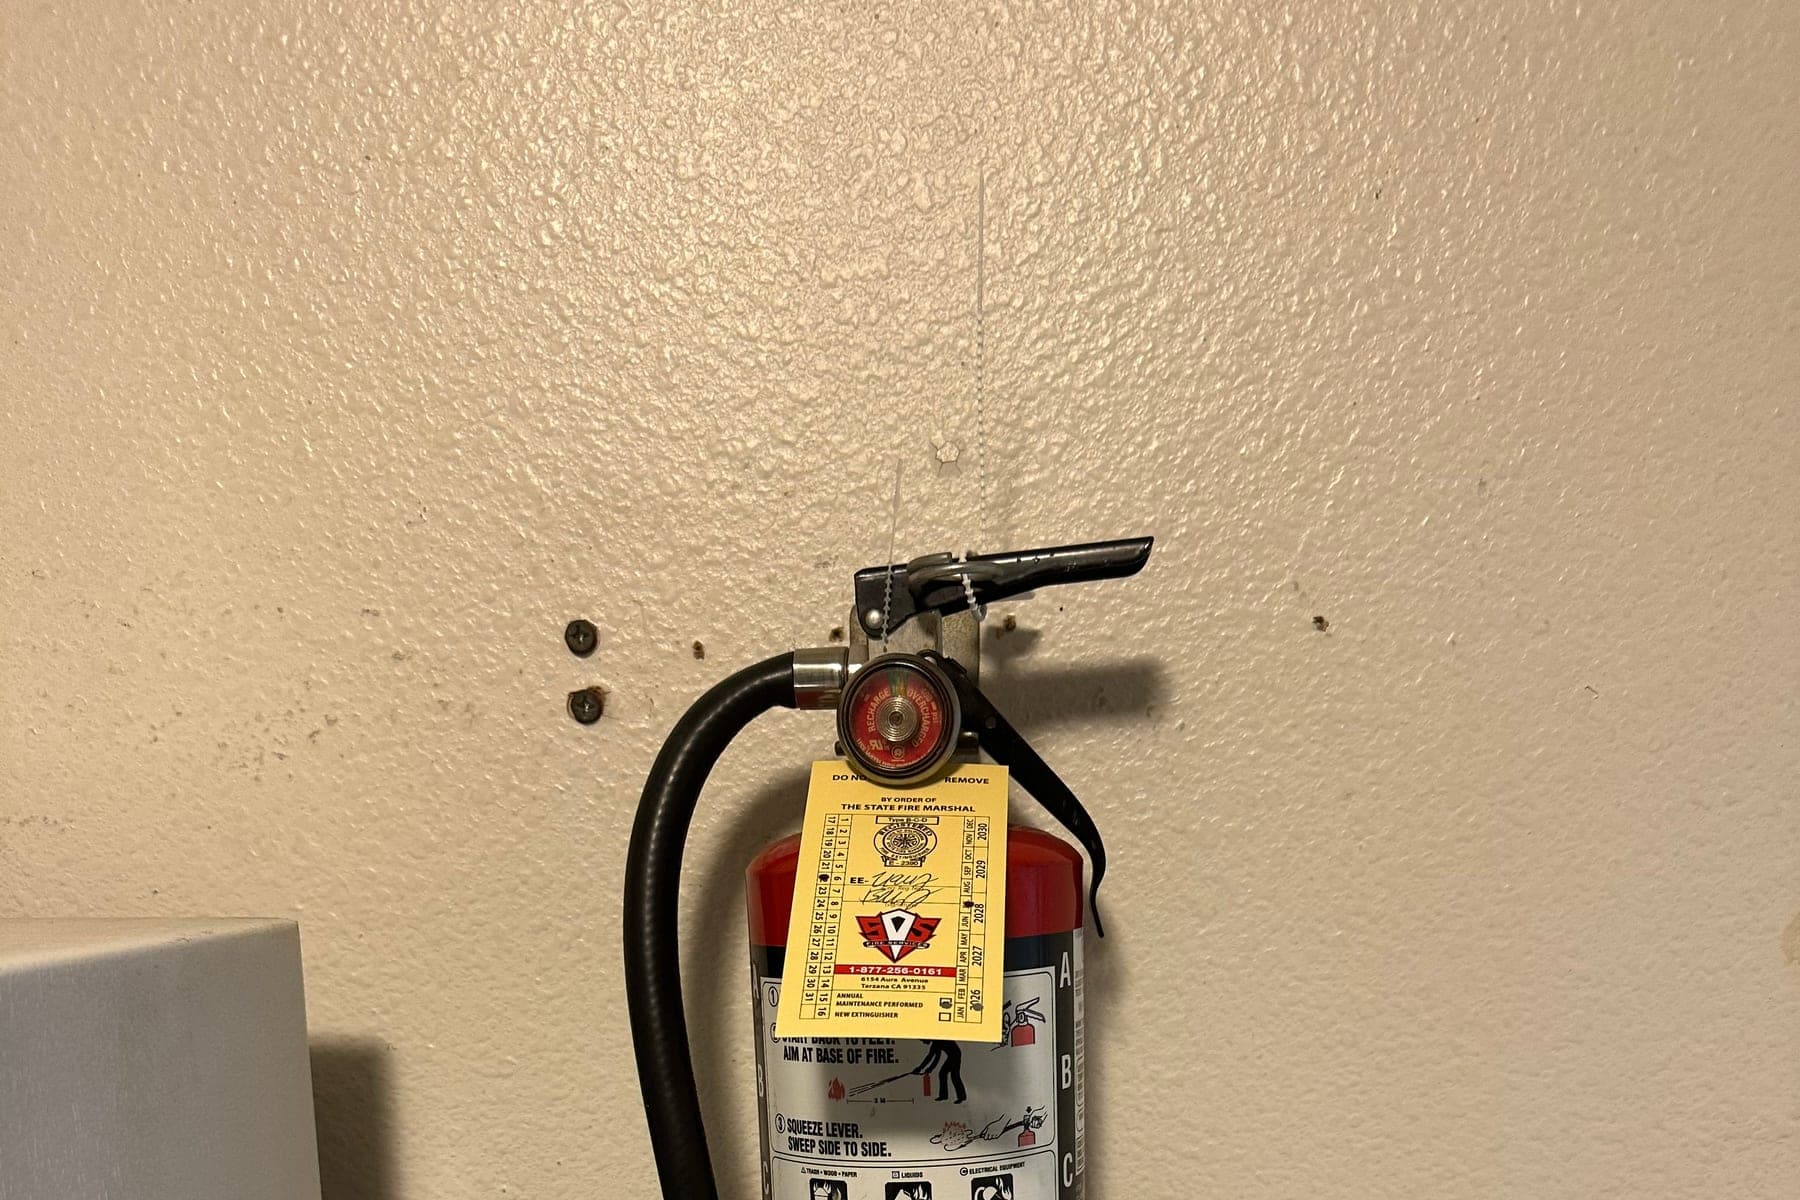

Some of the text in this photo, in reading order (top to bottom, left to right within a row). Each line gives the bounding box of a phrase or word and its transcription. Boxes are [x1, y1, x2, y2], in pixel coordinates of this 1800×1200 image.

[866, 687, 891, 733] RECHARGE
[944, 776, 989, 784] REMOVE
[828, 816, 836, 824] 17
[826, 827, 835, 835] 18
[977, 823, 988, 840] 2030
[825, 838, 833, 846] 19
[823, 850, 831, 858] 20
[822, 862, 830, 870] 21
[976, 860, 986, 879] 2029
[819, 887, 827, 895] 23
[960, 932, 968, 946] MAY
[965, 833, 973, 844] NOV
[817, 899, 825, 907] 24
[815, 912, 824, 920] 25
[974, 903, 984, 923] 2028
[814, 925, 822, 934] 26
[828, 925, 836, 934] 10
[812, 938, 820, 947] 27
[826, 938, 834, 946] 11
[810, 952, 819, 960] 28
[824, 952, 833, 960] 12
[972, 945, 982, 966] 2027
[809, 965, 817, 974] 29
[823, 965, 831, 974] 13
[849, 966, 942, 975] 1-877-256-0161
[1059, 951, 1071, 988] A
[807, 979, 815, 988] 30
[821, 979, 830, 988] 14
[805, 992, 814, 1001] 31
[819, 993, 828, 1002] 15
[818, 1007, 826, 1016] 16
[783, 1045, 899, 1064] AIM AT BASE OF FIRE.
[1061, 1054, 1072, 1090] B
[787, 1118, 823, 1137] SQUEEZE
[826, 1122, 863, 1139] LEVER.
[788, 1135, 892, 1157] SWEEP SIDE TO SIDE.
[970, 1166, 998, 1175] ELECTRICAL
[1000, 1161, 1025, 1171] EQUIPMENT
[1063, 1152, 1073, 1188] C
[824, 1169, 837, 1177] WOOD
